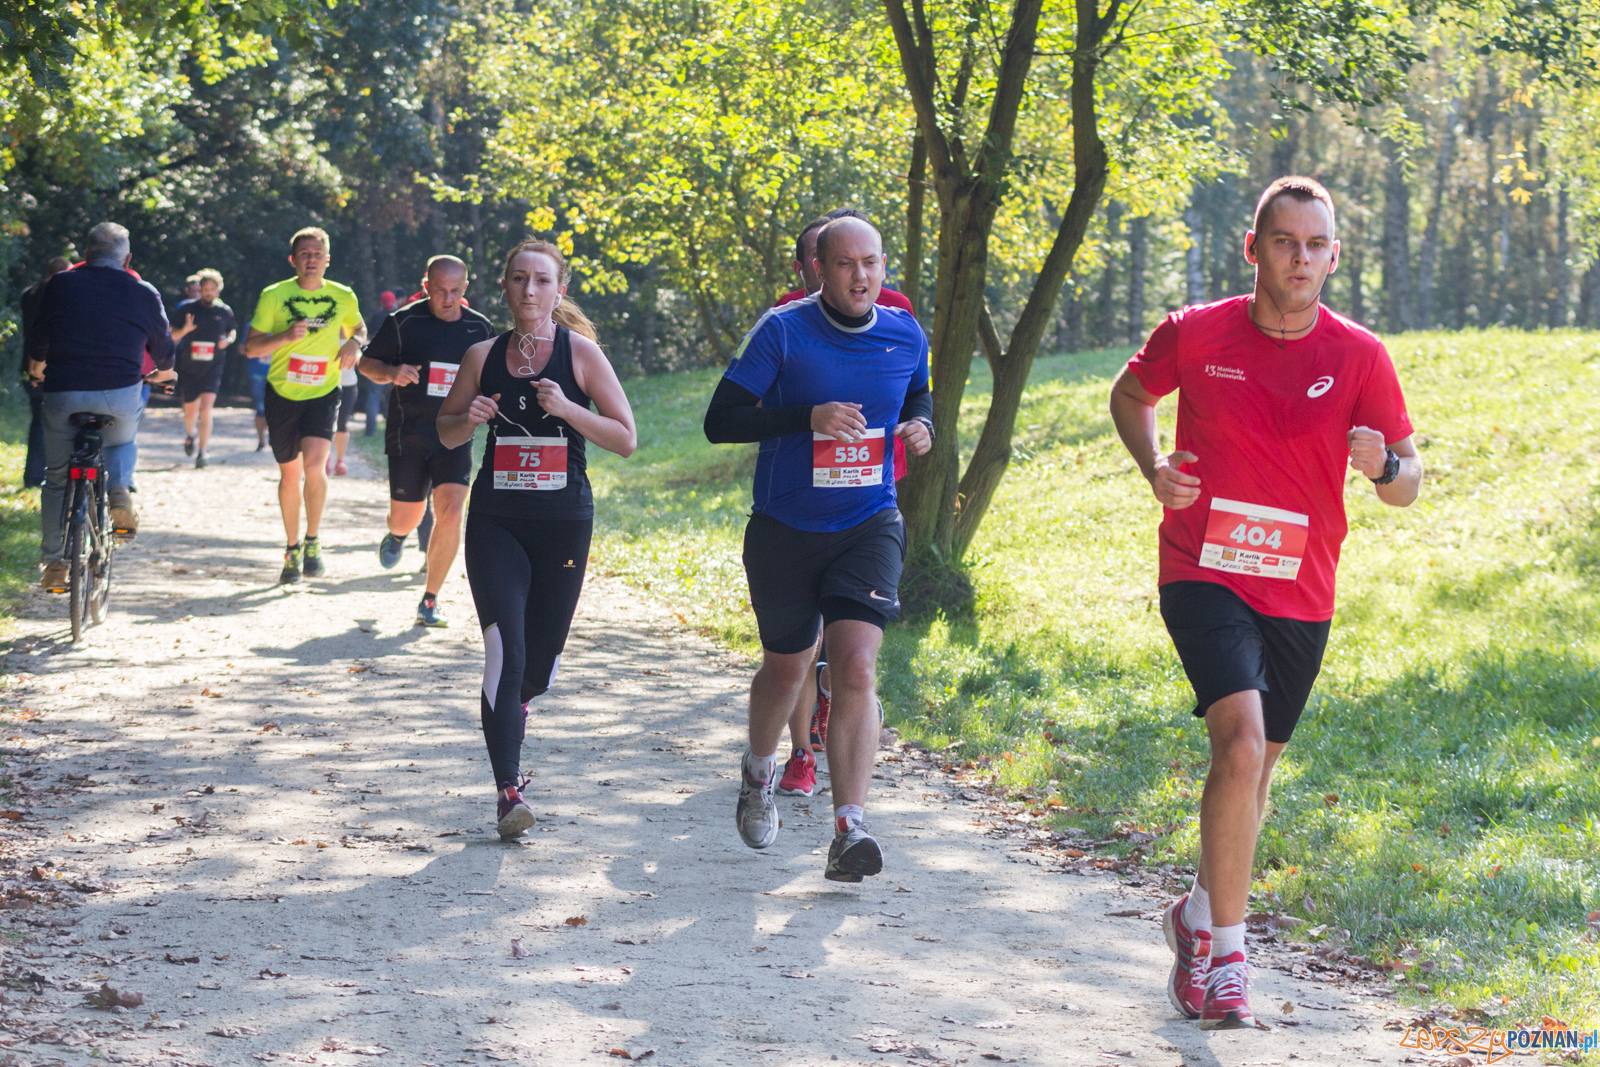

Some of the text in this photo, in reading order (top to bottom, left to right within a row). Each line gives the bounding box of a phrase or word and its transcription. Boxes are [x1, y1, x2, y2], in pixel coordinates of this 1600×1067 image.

[300, 364, 319, 374] 419
[1204, 364, 1244, 377] 13 Maniacka
[519, 396, 526, 410] S
[519, 452, 541, 468] 75
[834, 446, 870, 463] 536
[1229, 523, 1283, 550] 404
[1239, 551, 1261, 561] Karlik
